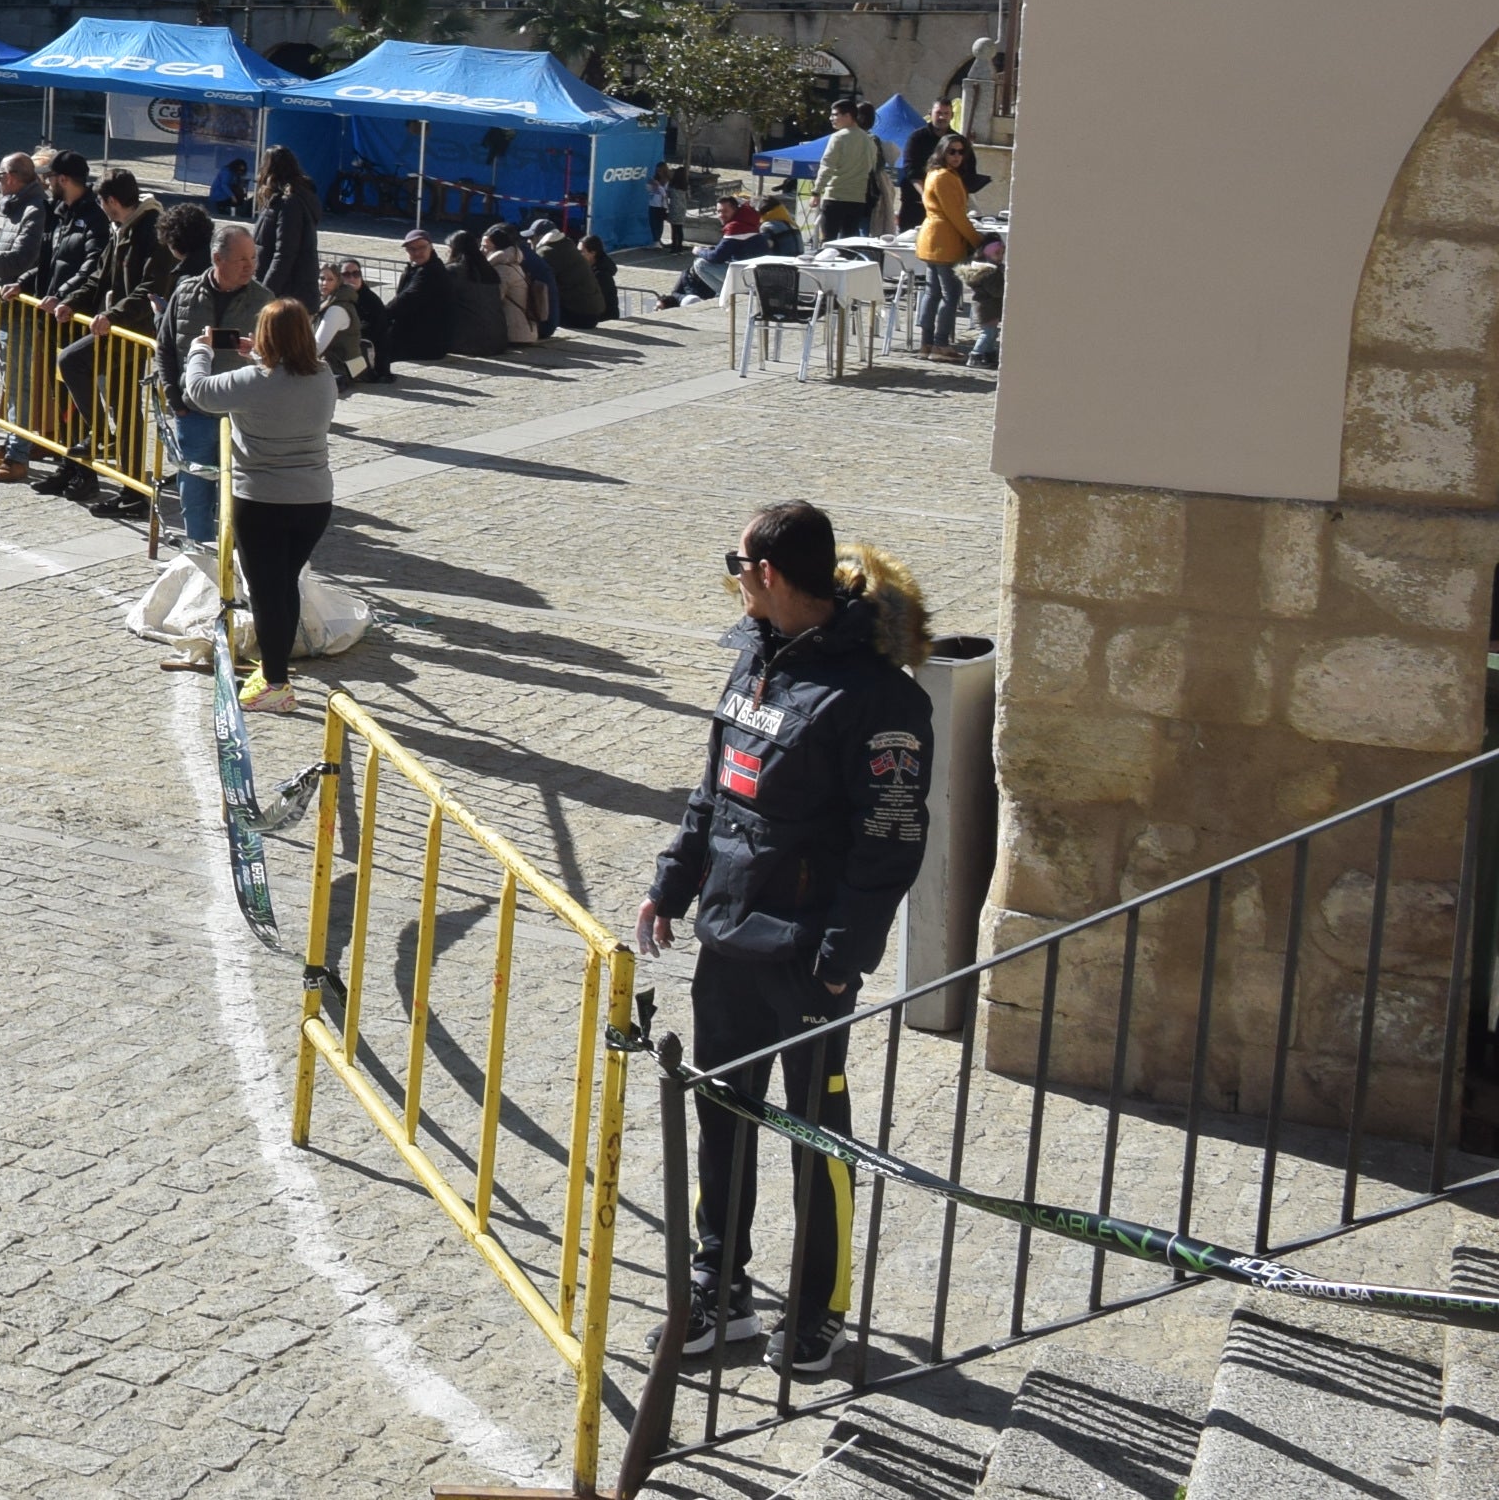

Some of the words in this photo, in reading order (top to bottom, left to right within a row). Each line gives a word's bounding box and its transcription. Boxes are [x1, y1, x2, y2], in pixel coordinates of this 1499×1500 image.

[30, 54, 226, 80] ORBEA
[203, 91, 255, 102] ORBEA
[281, 96, 333, 109] ORBEA
[335, 85, 540, 115] ORBEA
[603, 166, 648, 183] ORBEA
[724, 694, 782, 735] NORWAY
[802, 1015, 829, 1025] FILA
[597, 1131, 622, 1229] AYTO
